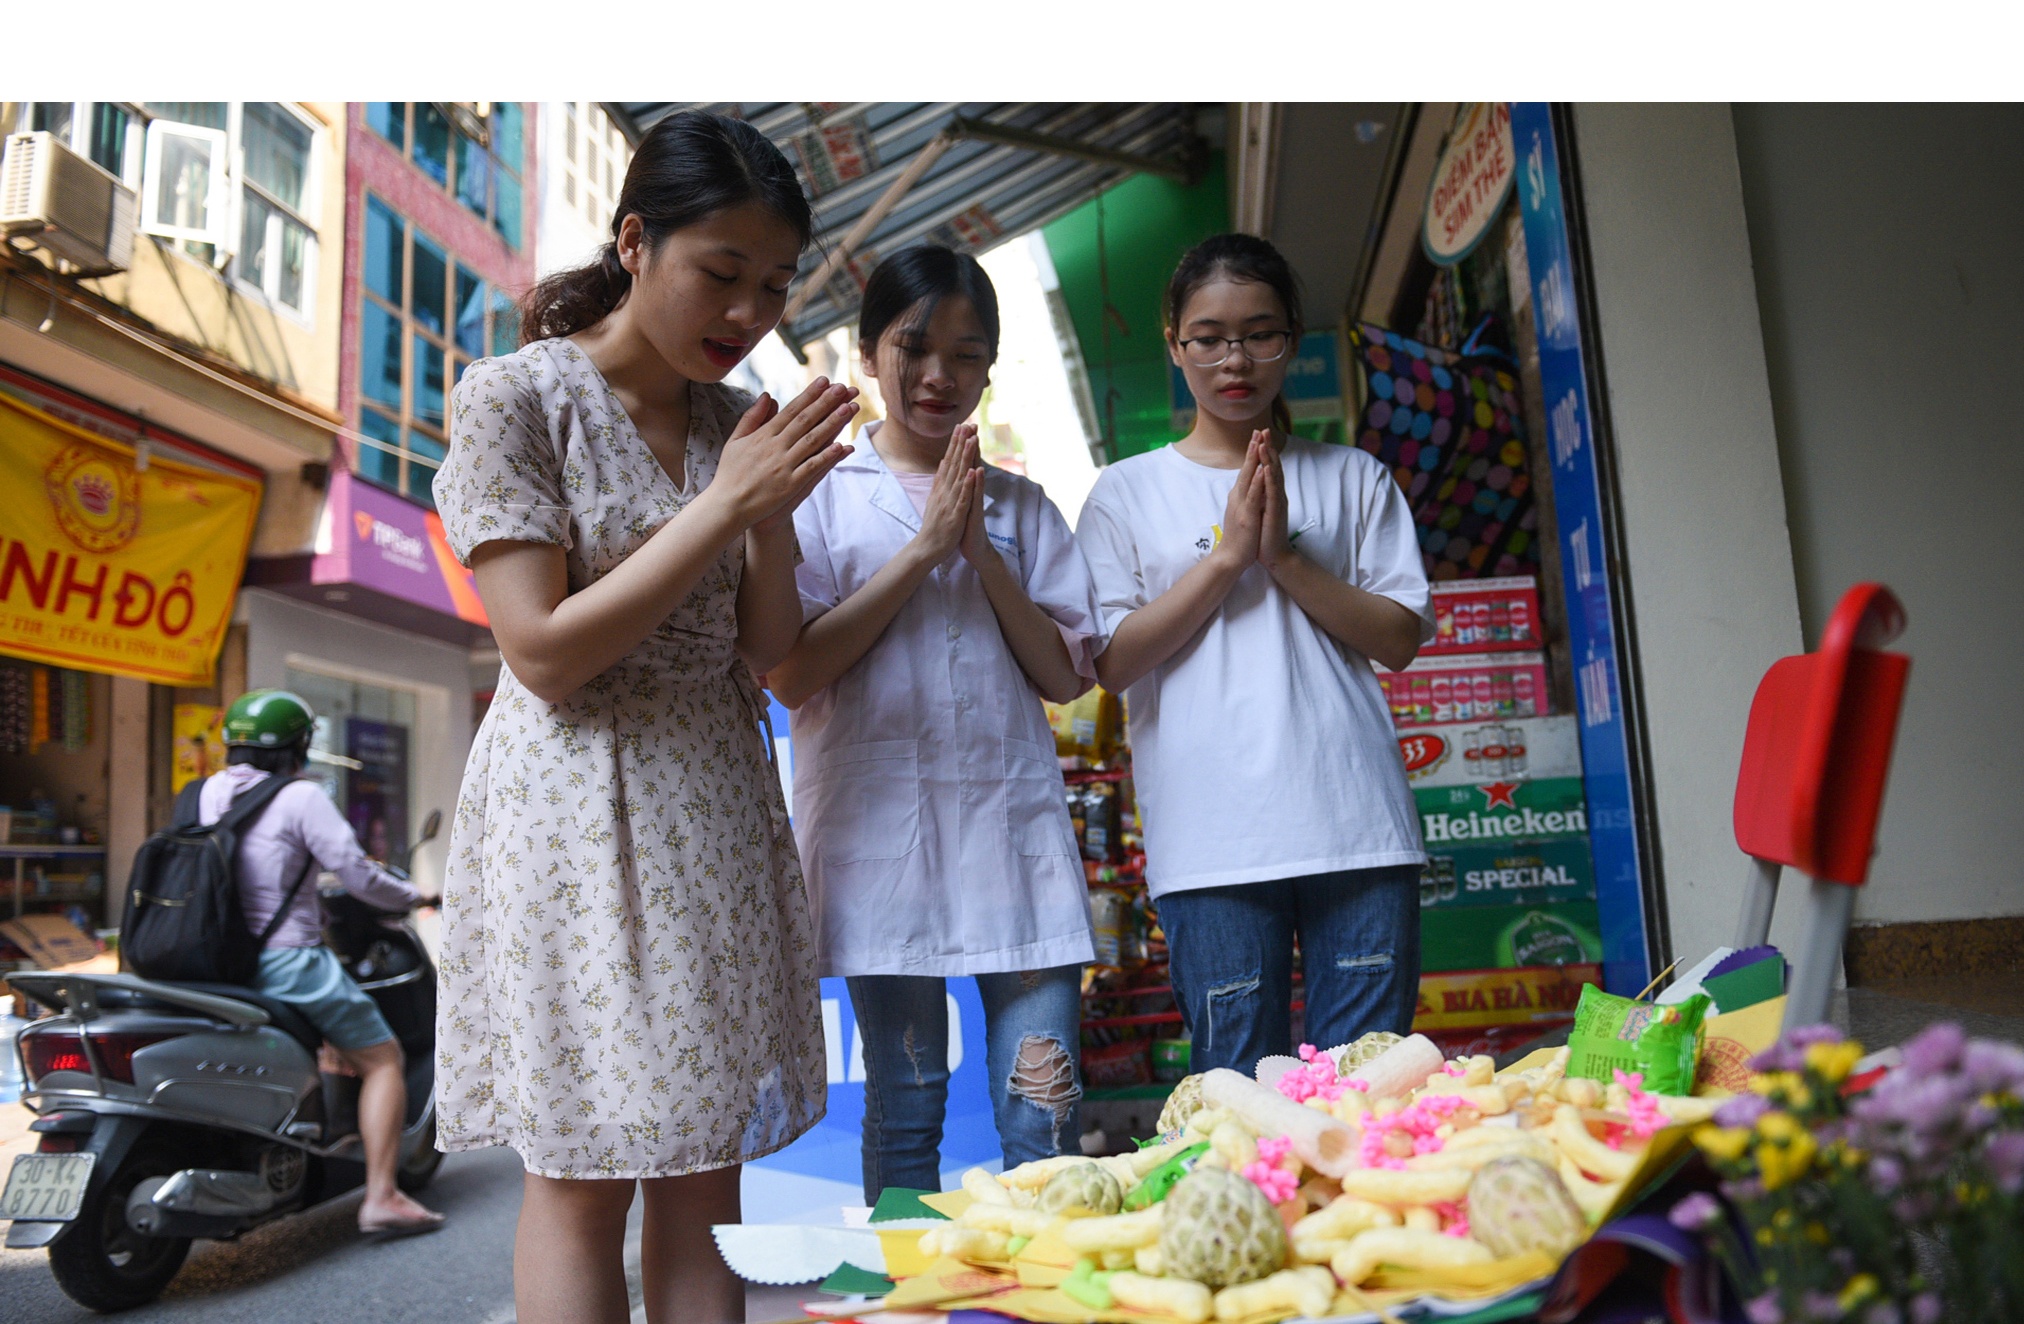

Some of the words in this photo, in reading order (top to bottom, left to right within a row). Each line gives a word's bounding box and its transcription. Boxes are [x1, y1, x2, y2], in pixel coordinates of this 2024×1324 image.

[1443, 191, 1473, 245] SIM
[0, 535, 109, 622] NH
[113, 568, 196, 639] ĐÔ
[1401, 738, 1426, 765] 33
[1424, 806, 1588, 842] Heineken
[1464, 865, 1577, 892] SPECIAL
[1442, 988, 1488, 1013] BIA
[9, 1188, 71, 1215] 8770
